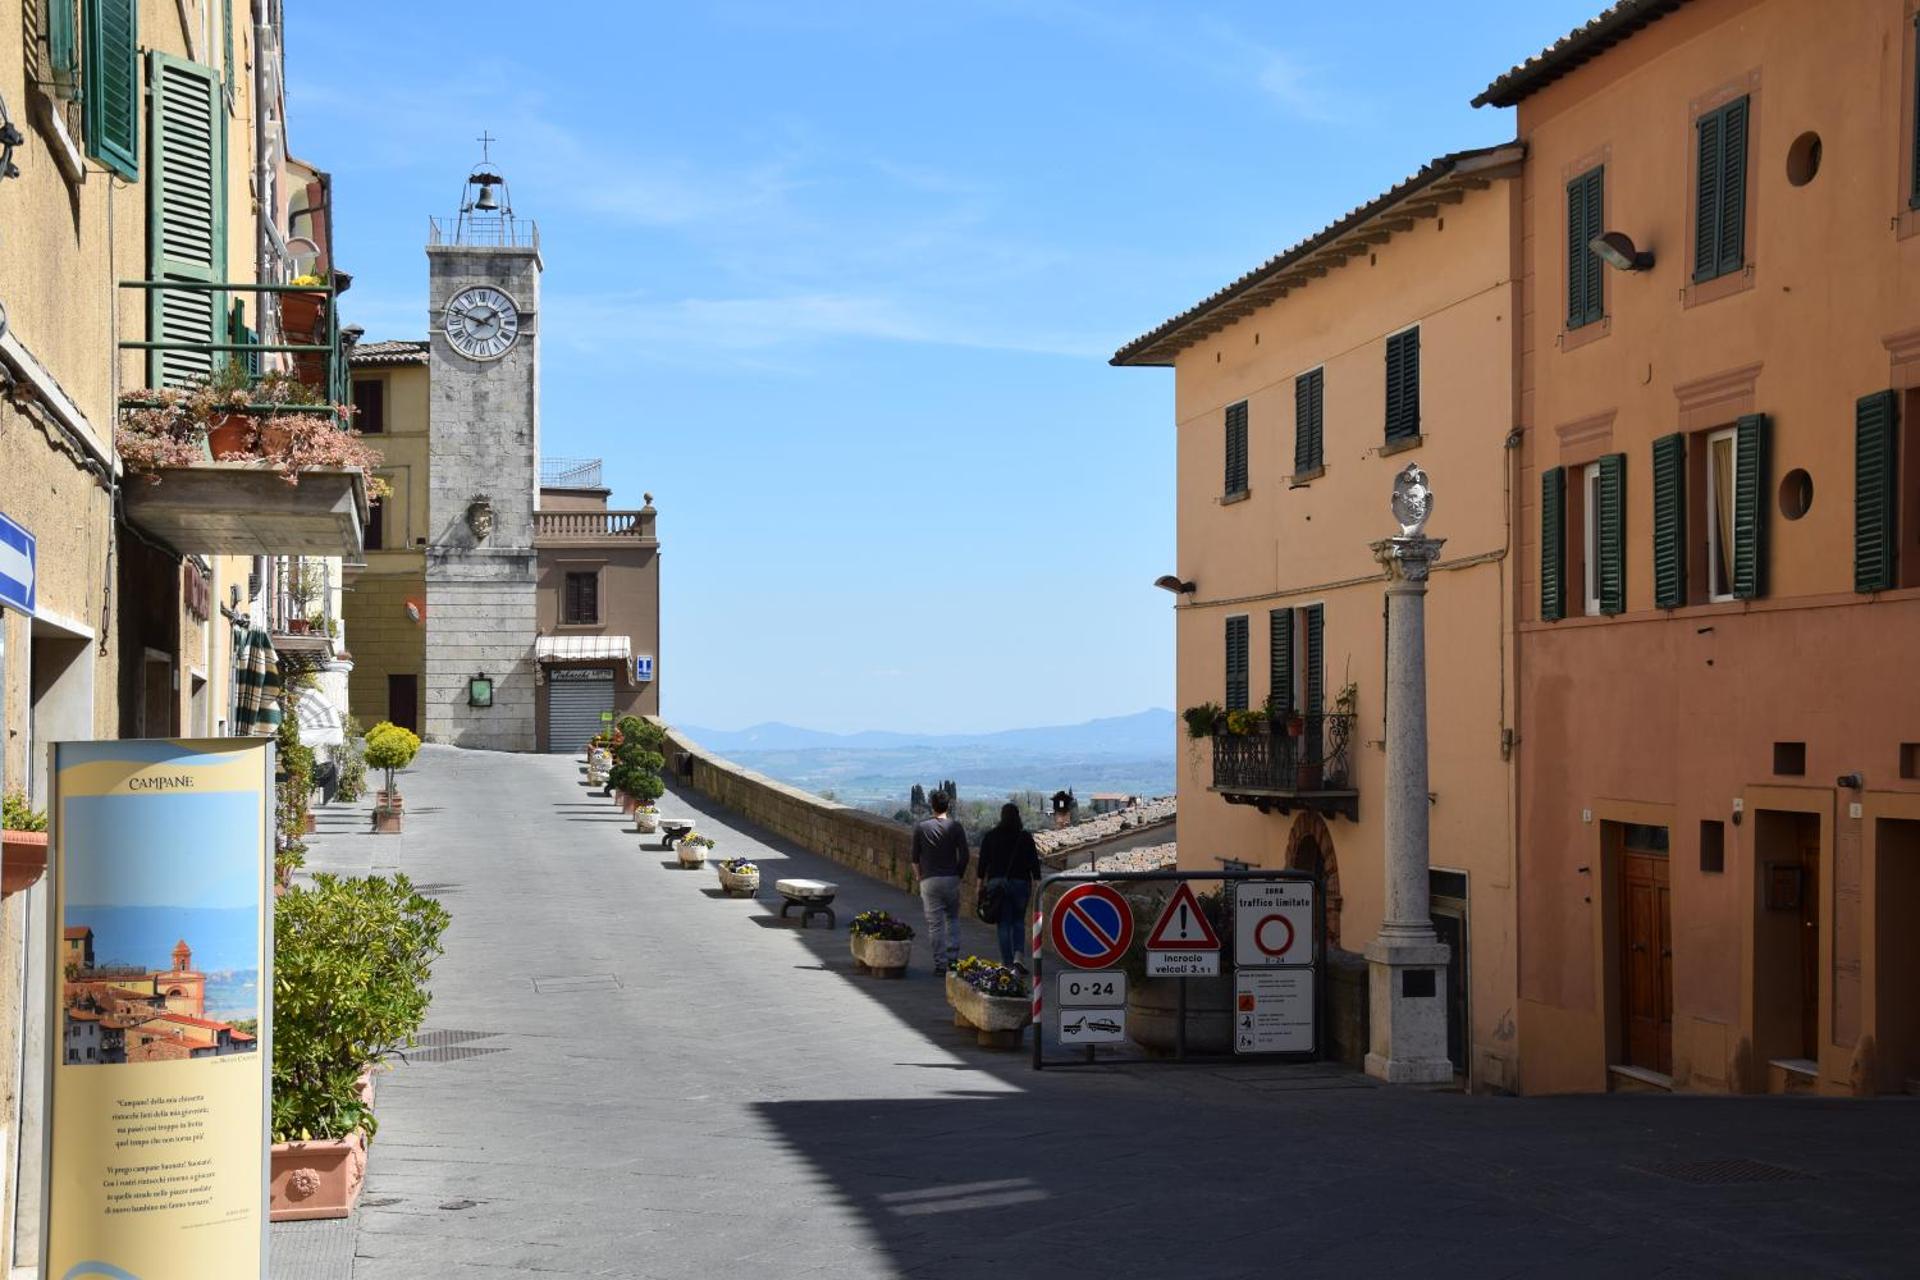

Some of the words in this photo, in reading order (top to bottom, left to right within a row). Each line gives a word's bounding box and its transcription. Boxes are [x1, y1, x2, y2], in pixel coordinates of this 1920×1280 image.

[128, 776, 194, 790] CAMPANE
[1239, 898, 1273, 907] traffico
[1156, 965, 1187, 973] veicoli
